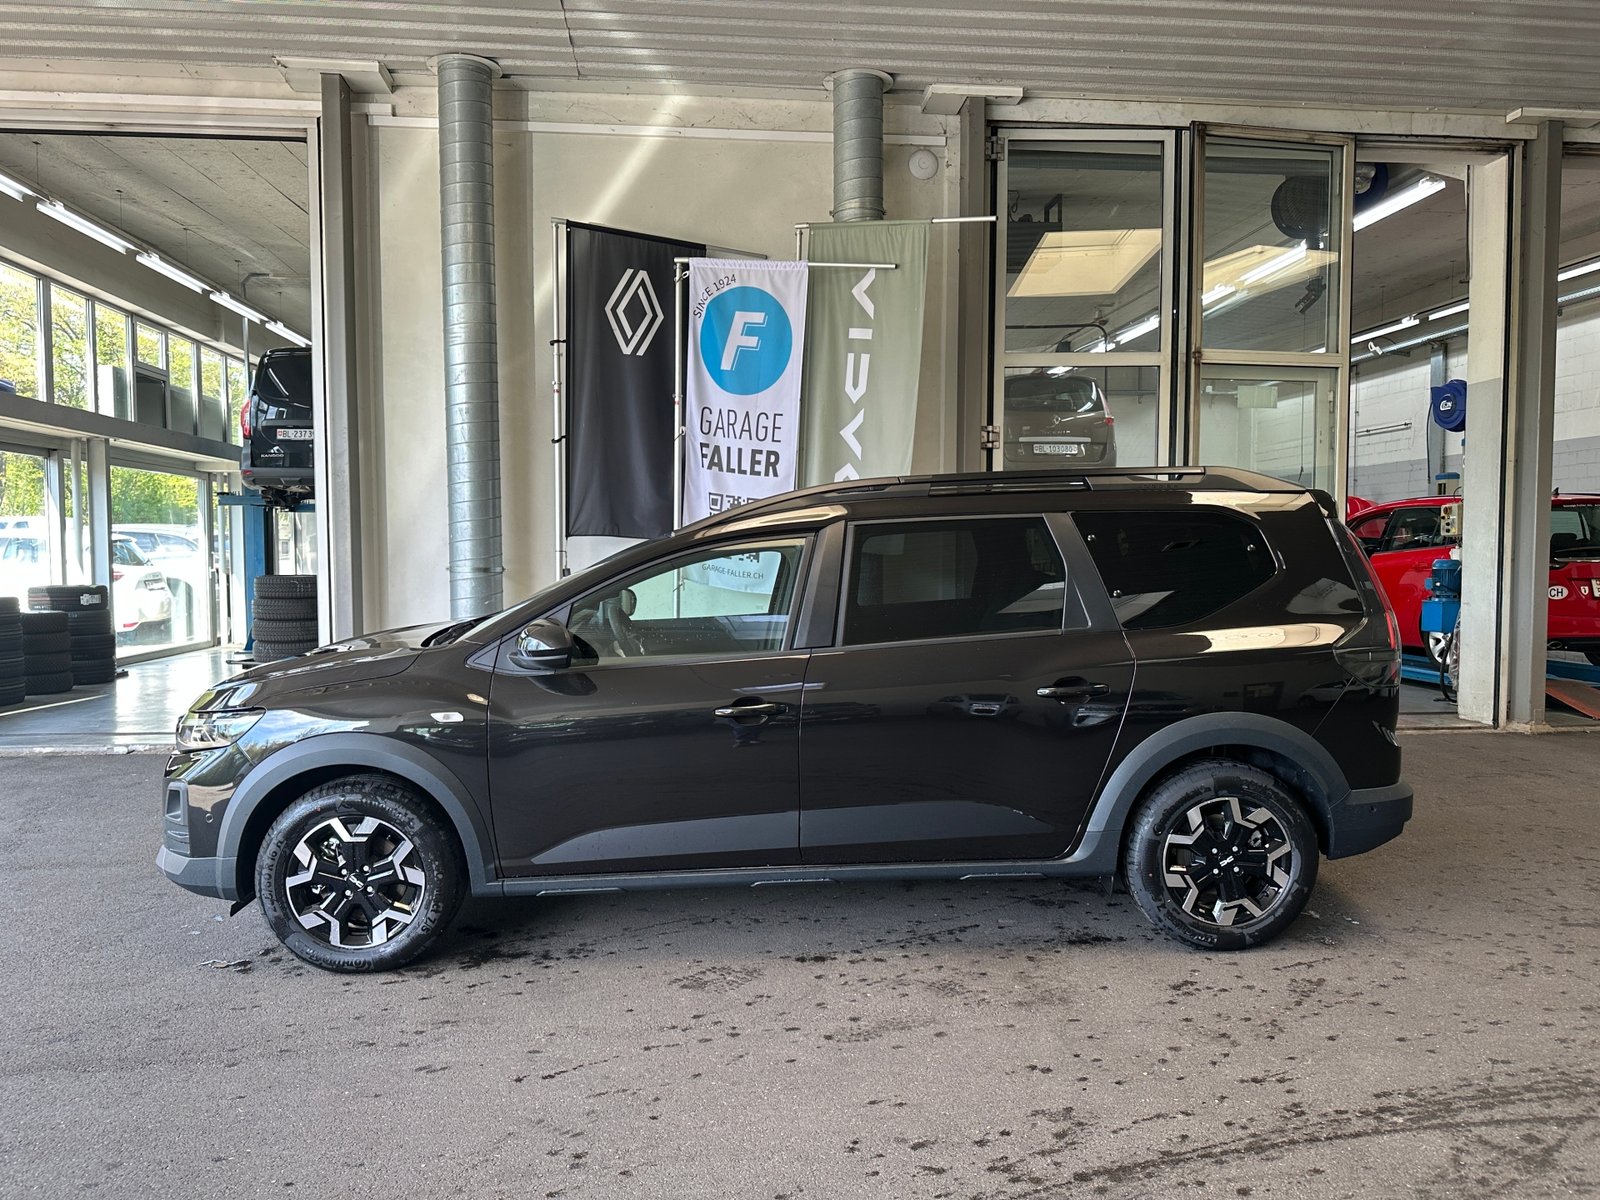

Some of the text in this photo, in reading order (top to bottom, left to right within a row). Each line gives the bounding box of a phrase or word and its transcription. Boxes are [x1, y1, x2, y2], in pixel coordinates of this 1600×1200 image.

[692, 273, 737, 320] SINCE 1924
[699, 406, 784, 443] GARAGE
[699, 442, 781, 478] FALLER
[1549, 588, 1564, 598] CH
